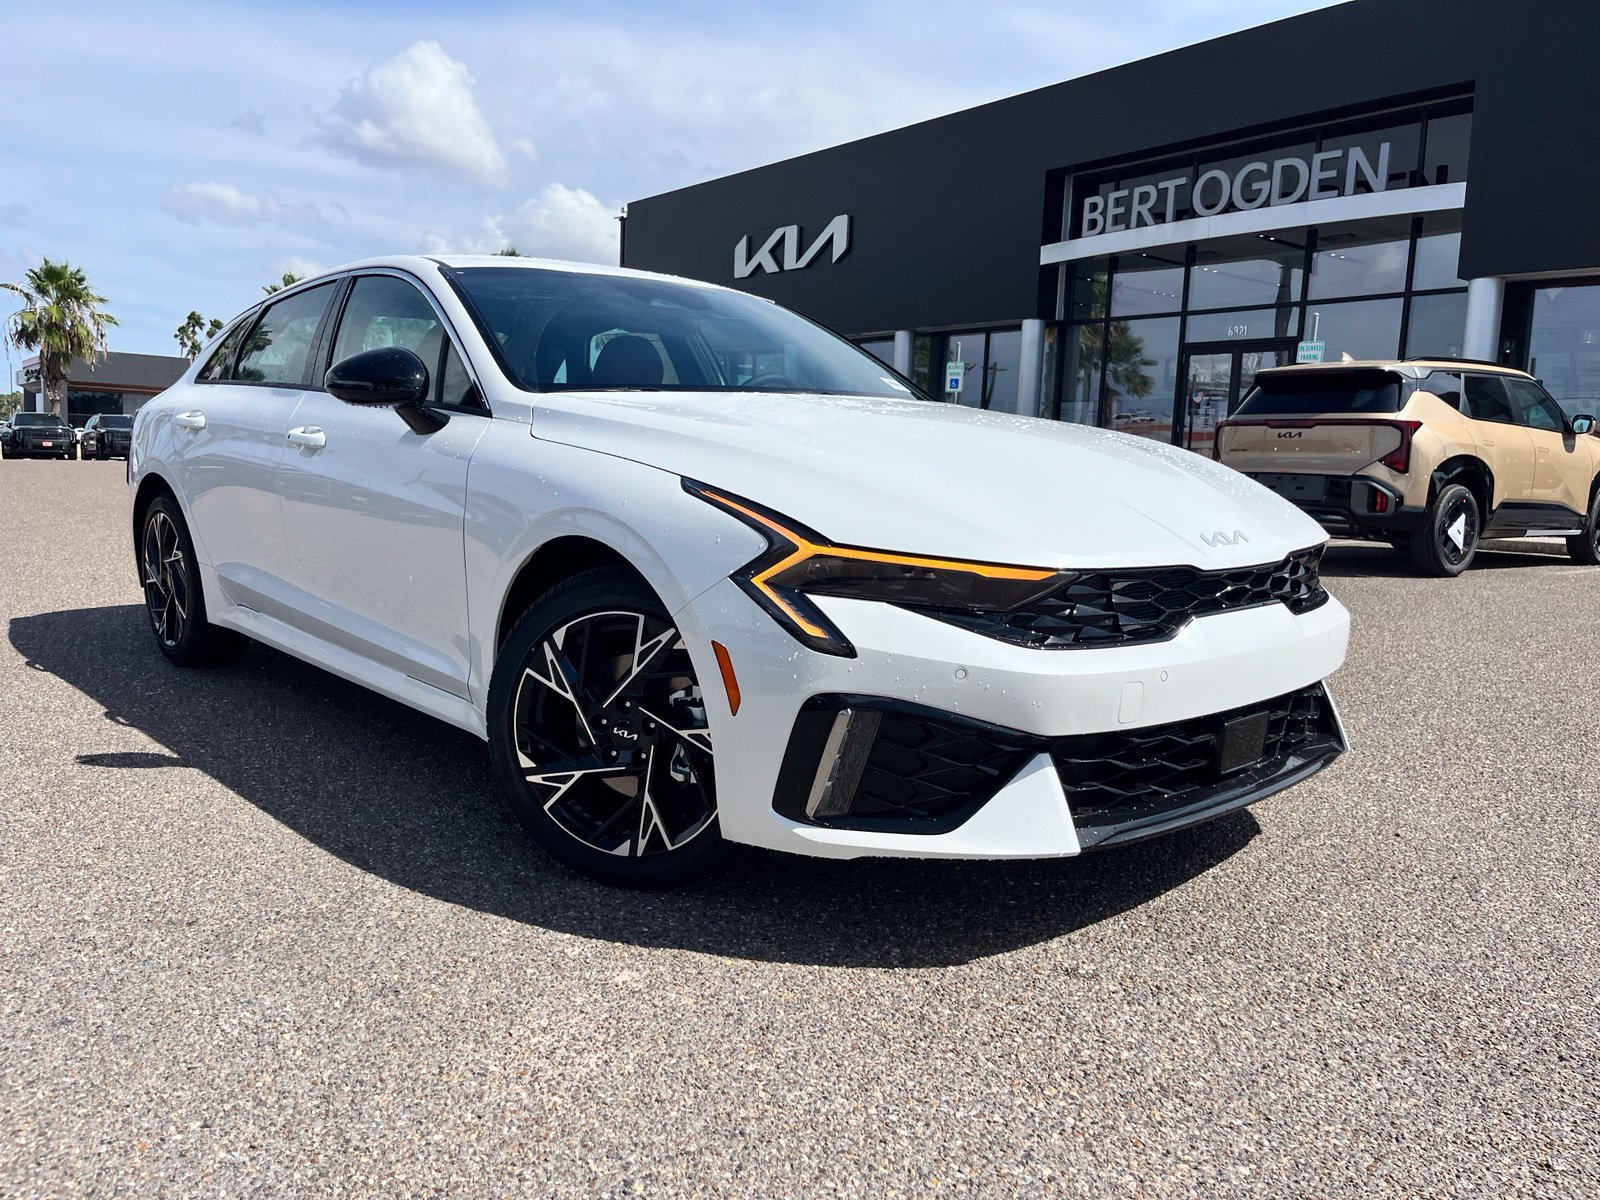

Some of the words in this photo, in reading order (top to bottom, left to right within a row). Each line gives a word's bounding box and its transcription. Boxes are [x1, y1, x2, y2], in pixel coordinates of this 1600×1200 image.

[1082, 176, 1190, 237] BERT
[1192, 142, 1391, 217] OGDEN
[733, 214, 852, 279] KIA
[1277, 431, 1303, 439] KIA
[1200, 529, 1249, 548] KIA
[613, 727, 638, 741] KIA
